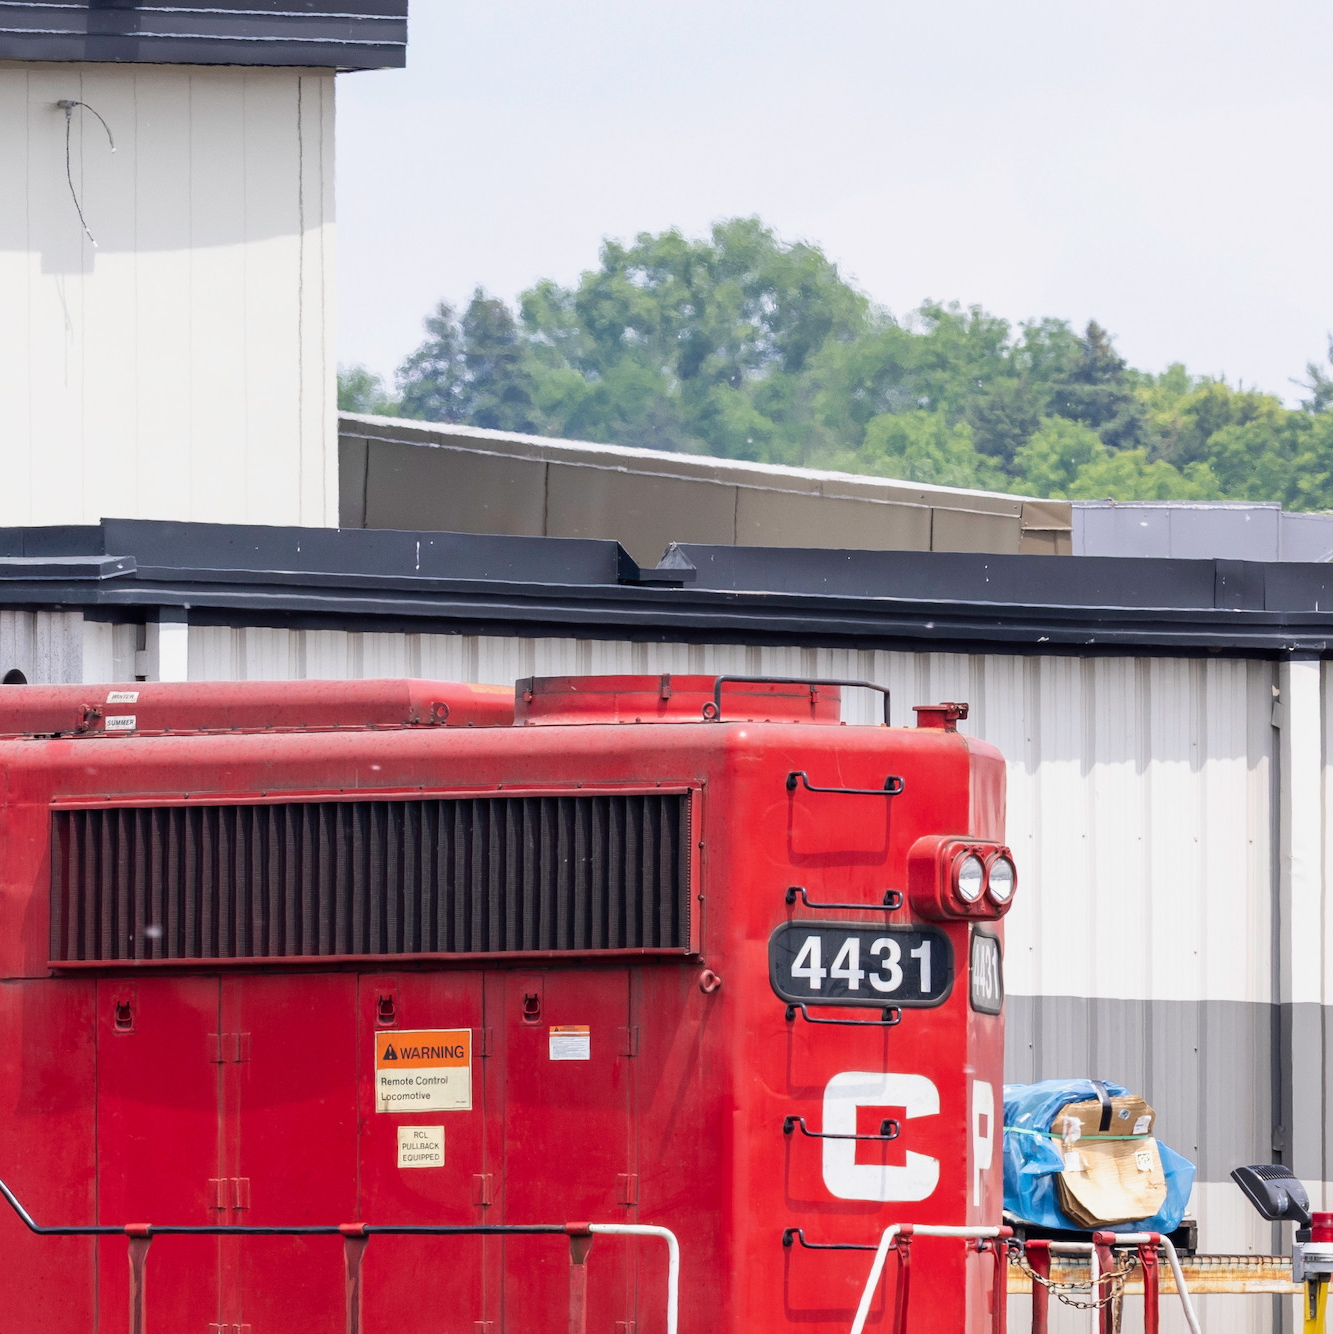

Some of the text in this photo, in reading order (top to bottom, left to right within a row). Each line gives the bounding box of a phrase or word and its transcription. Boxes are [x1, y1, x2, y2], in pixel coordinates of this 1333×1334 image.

[790, 935, 932, 993] 4431
[973, 943, 999, 1000] 4431
[400, 1045, 465, 1060] WARNING
[381, 1076, 449, 1086] Remote Control
[381, 1091, 431, 1101] Locomotive
[413, 1131, 429, 1139] RCL
[822, 1071, 994, 1207] C P
[402, 1142, 440, 1150] PULLBACK
[402, 1154, 440, 1162] EQUIPPED
